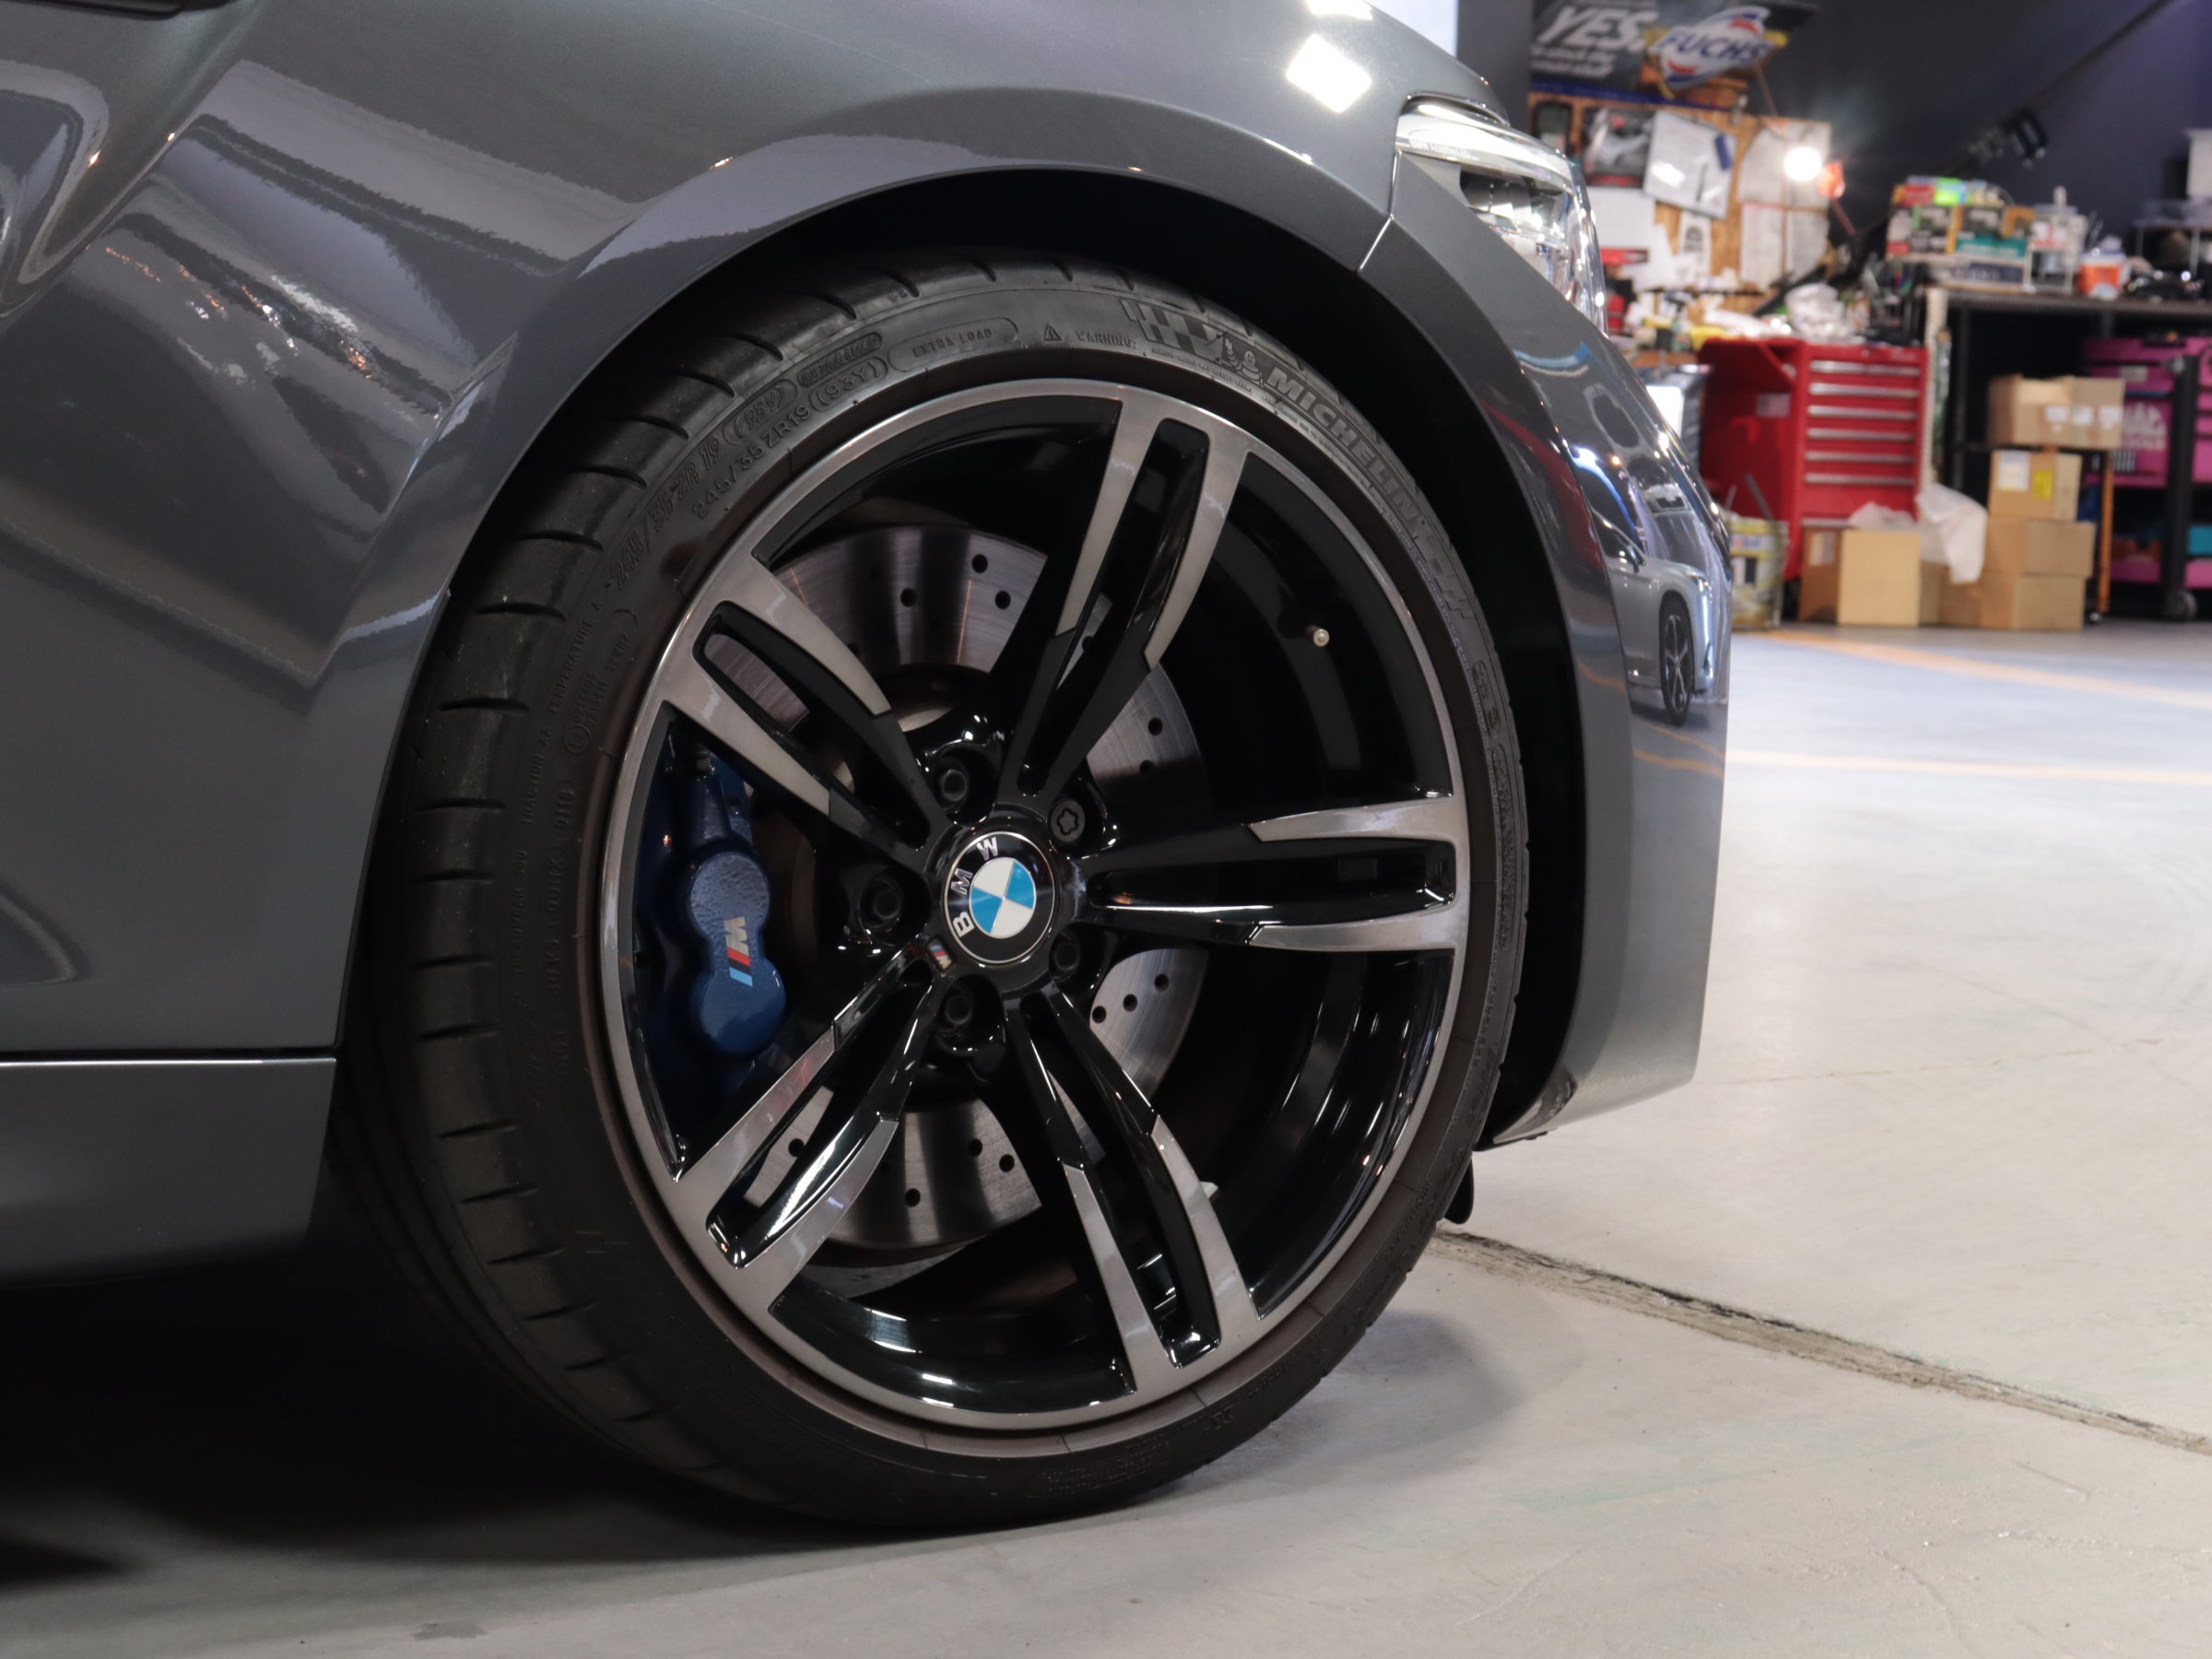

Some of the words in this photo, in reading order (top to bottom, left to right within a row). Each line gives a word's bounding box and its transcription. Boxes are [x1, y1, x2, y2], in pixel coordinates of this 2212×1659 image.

[959, 326, 992, 345] LOAD
[817, 360, 879, 406] (93Y)
[1266, 366, 1422, 524] MICHELIN
[950, 836, 998, 937] BMW
